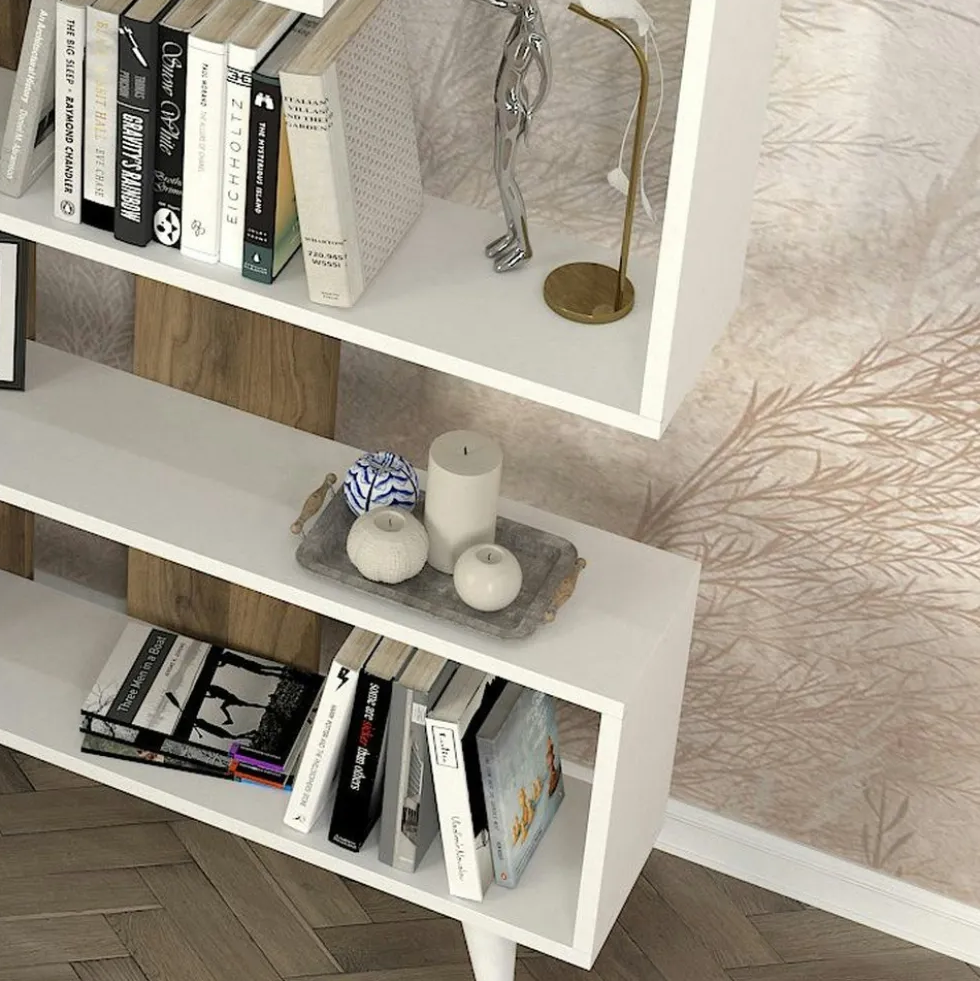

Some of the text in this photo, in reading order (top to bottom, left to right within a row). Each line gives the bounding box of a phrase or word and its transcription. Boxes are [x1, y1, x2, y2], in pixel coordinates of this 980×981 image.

[20, 9, 49, 104] An Architectural History
[65, 19, 75, 86] THE BIG SLEEP
[159, 41, 182, 156] Snow White
[64, 96, 75, 194] RAYMOND CHANDLER
[120, 113, 144, 223] GRAVITY'S RAINBOW
[227, 99, 243, 224] EICHHOLTZ
[254, 122, 266, 214] THE MYSTERIOUS ISLAND
[117, 689, 138, 712] Three
[130, 671, 149, 691] Men
[140, 661, 154, 671] in
[149, 636, 167, 655] Boat
[364, 705, 375, 721] are
[367, 683, 380, 707] some
[350, 765, 366, 791] others
[356, 746, 370, 765] than
